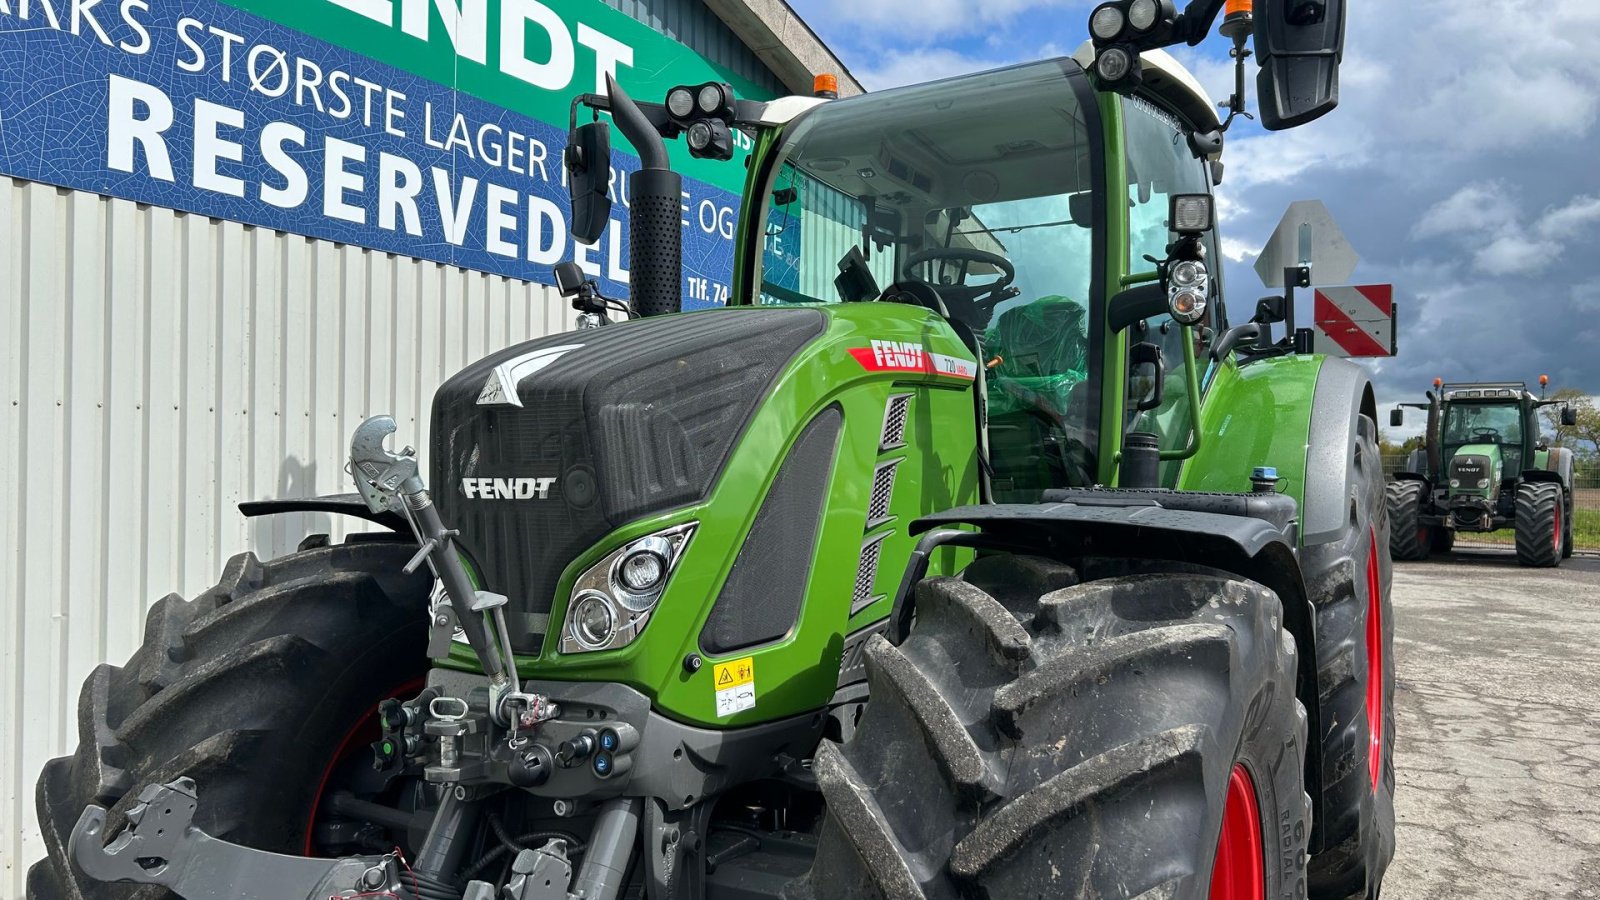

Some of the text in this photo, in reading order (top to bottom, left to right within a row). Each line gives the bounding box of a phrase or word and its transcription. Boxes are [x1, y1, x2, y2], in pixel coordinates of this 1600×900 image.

[176, 17, 406, 138] STØRSTE
[424, 102, 548, 182] LAGER
[699, 199, 734, 239] OG
[870, 339, 923, 368] FENDT
[944, 358, 956, 373] 720
[462, 477, 558, 500] FENDT
[1280, 809, 1293, 880] RADIAL
